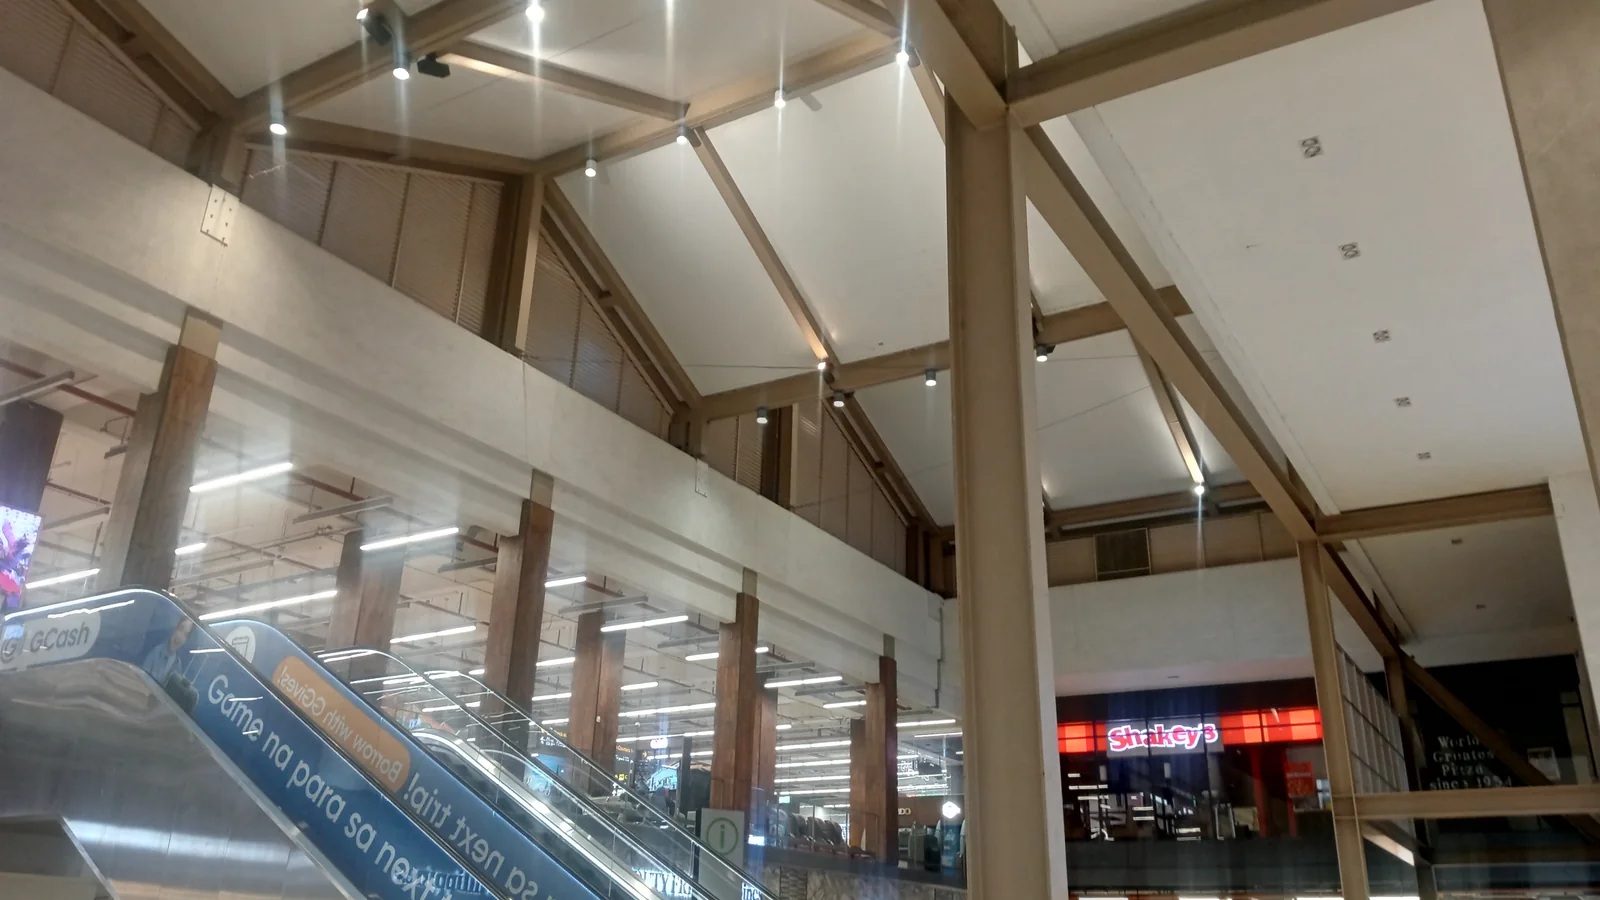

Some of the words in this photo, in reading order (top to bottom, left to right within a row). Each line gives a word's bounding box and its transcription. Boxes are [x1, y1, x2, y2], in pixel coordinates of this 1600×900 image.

[30, 622, 90, 653] GCash
[1107, 723, 1219, 752] Shakey's
[208, 674, 264, 742] Game
[262, 731, 294, 771] na
[286, 759, 347, 824] para
[344, 812, 377, 853] sa
[375, 841, 437, 900] next
